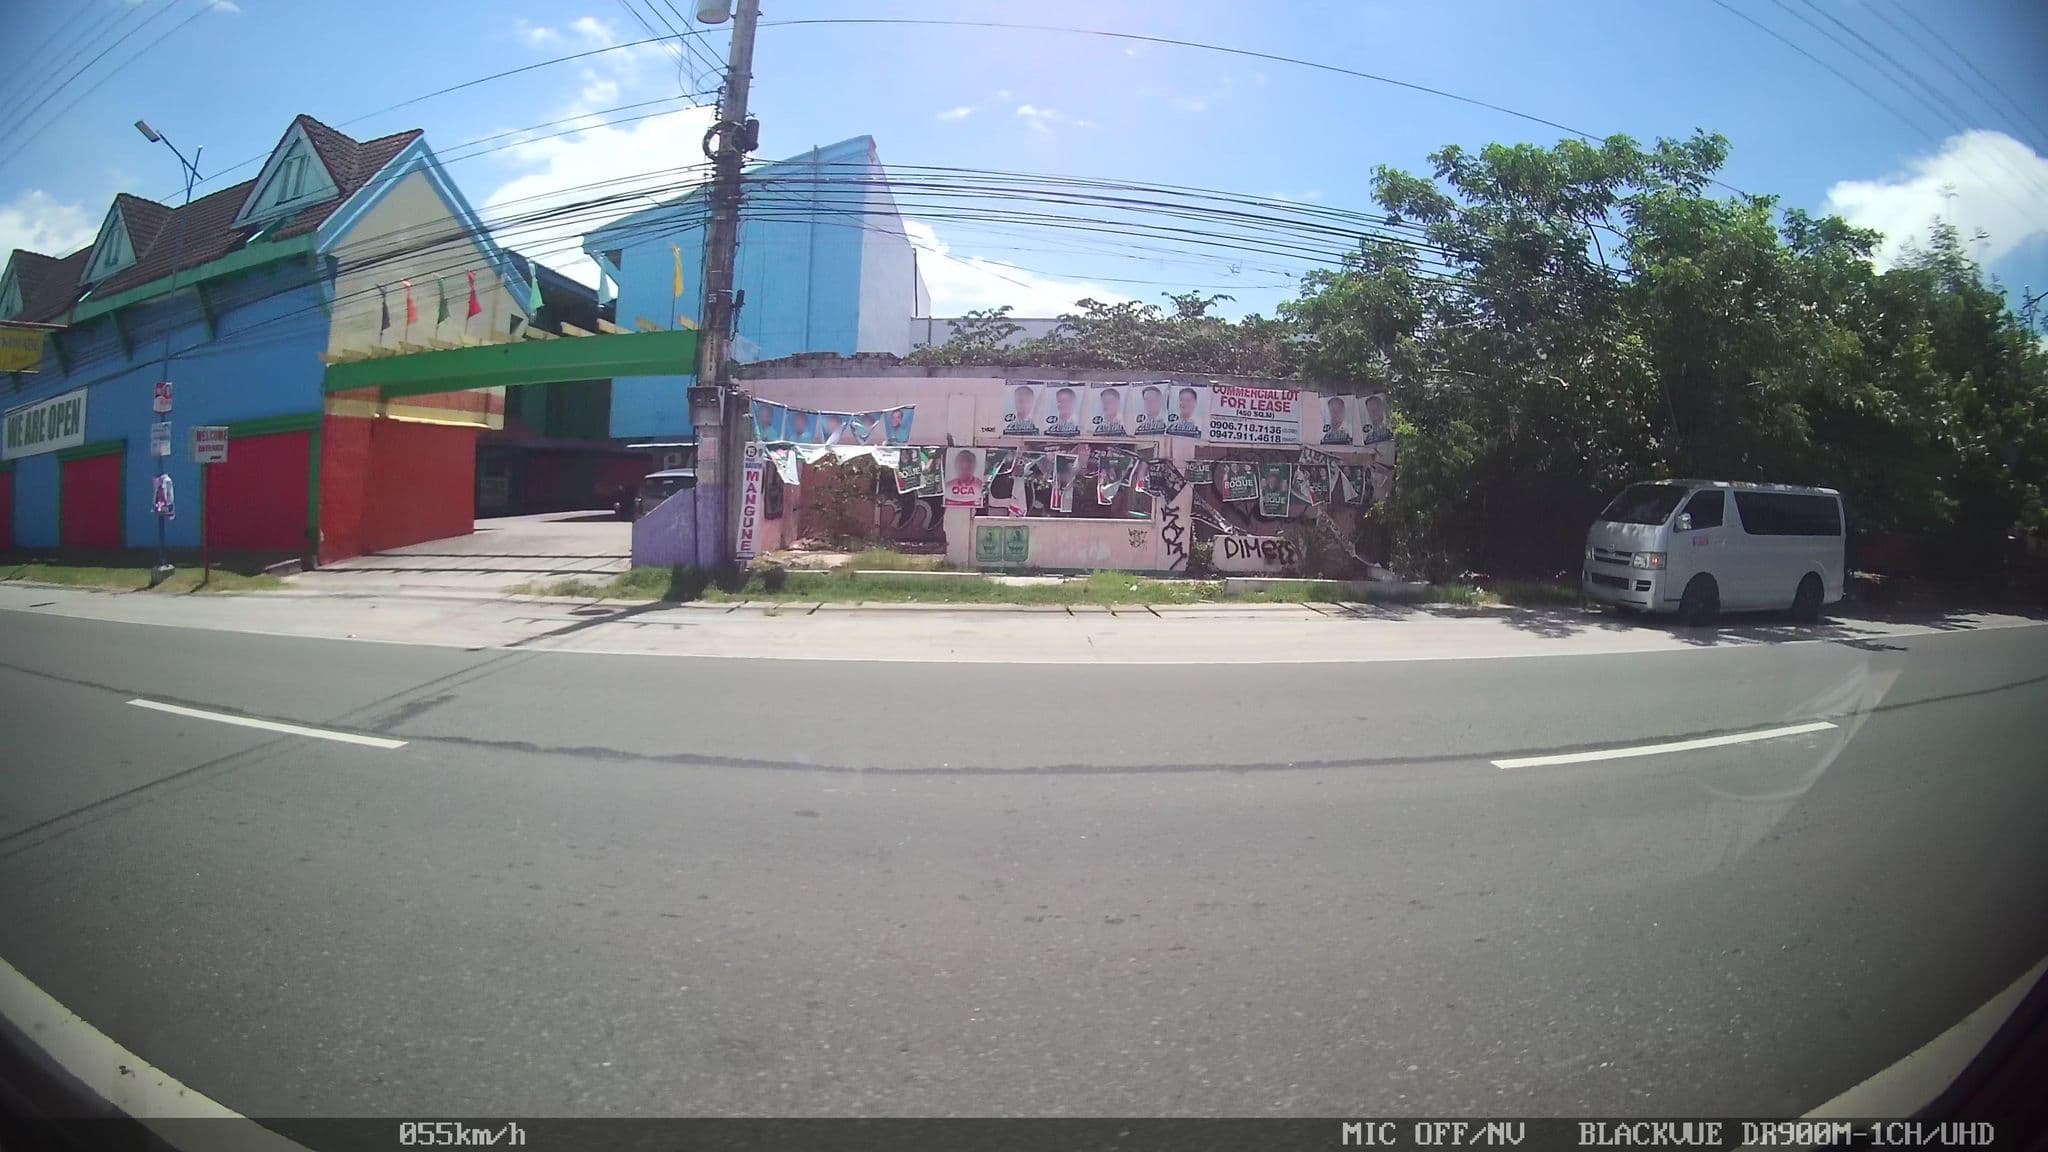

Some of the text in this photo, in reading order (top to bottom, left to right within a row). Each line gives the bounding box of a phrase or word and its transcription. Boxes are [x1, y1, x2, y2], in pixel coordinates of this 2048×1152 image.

[1212, 384, 1299, 401] COMMERCIAL LOT
[1220, 396, 1291, 413] FOR LEASE
[7, 396, 81, 449] WE ARE OPEN
[952, 486, 975, 495] OCA
[1224, 479, 1254, 489] ROQUE
